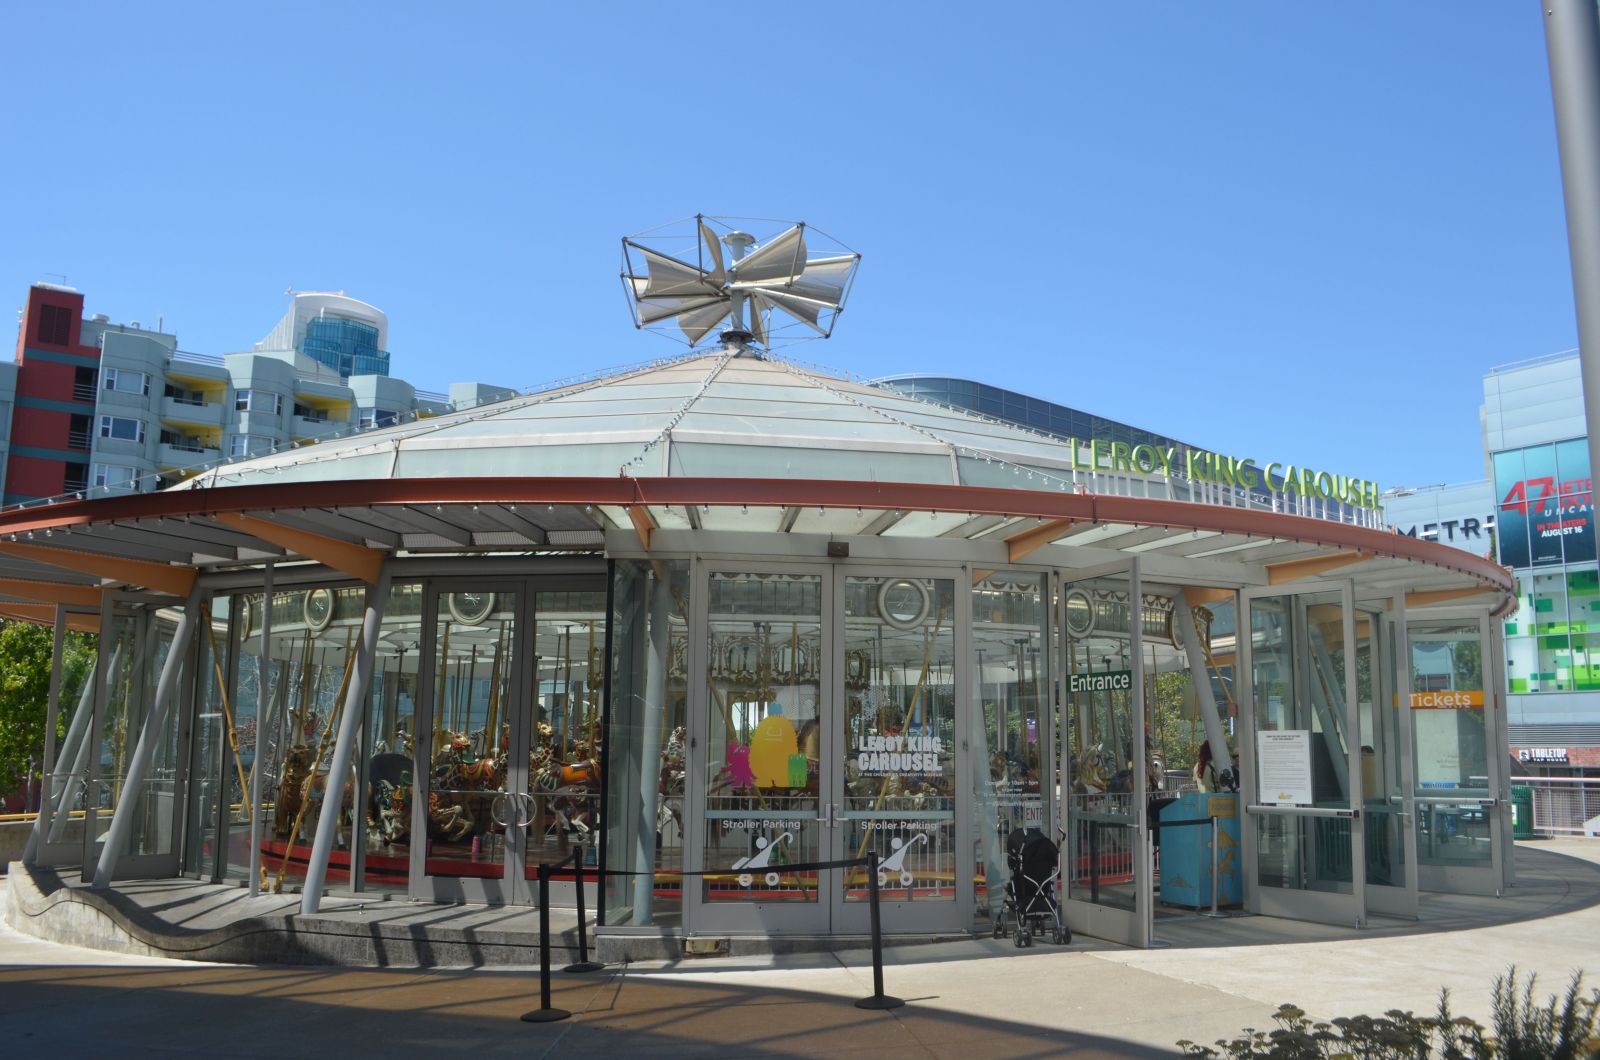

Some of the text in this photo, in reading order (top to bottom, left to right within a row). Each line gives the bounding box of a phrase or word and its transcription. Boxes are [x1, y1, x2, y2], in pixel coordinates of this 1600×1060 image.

[1071, 437, 1385, 511] LEROY KING CAROUSEL
[1501, 476, 1554, 515] 47
[1541, 526, 1583, 538] AUGUST 16
[1070, 674, 1130, 692] Entrance
[1409, 692, 1472, 707] Tickets
[859, 735, 942, 752] LEROY KING
[1531, 748, 1567, 758] TABLETOP
[858, 752, 943, 771] CAROUSEL
[722, 820, 801, 830] Stroller Parking
[861, 821, 937, 831] Stroller Parking
